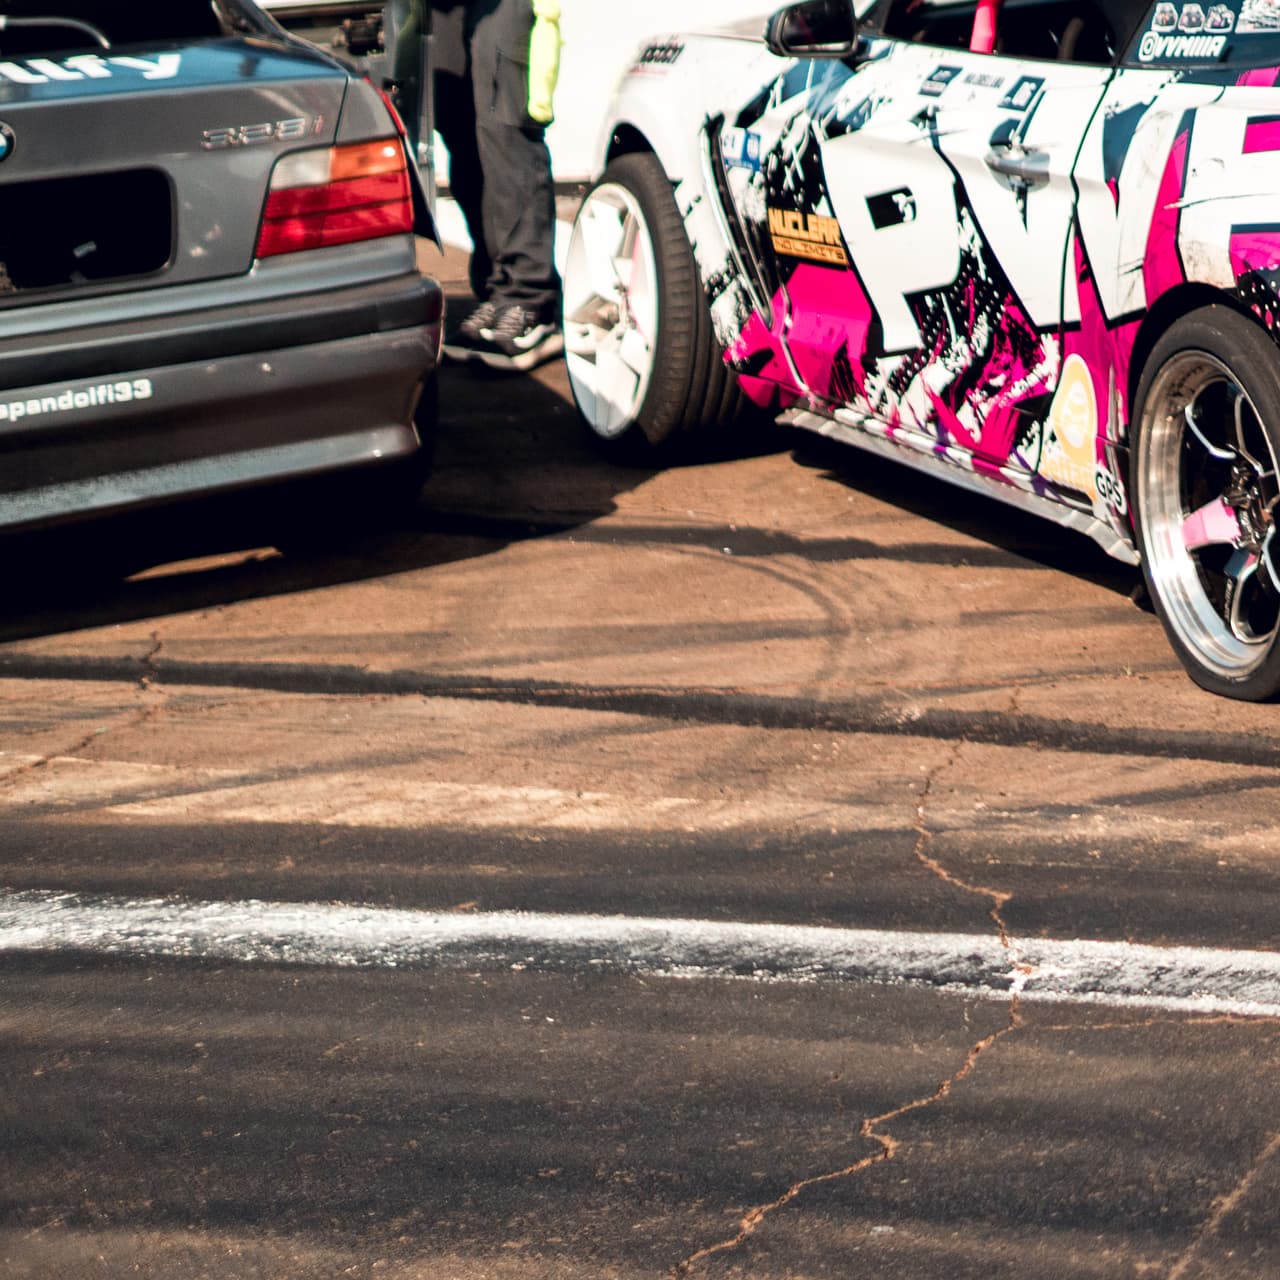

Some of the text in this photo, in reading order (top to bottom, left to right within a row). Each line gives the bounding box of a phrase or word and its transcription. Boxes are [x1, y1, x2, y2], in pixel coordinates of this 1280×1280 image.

[767, 207, 842, 246] NUCLEAR
[794, 240, 845, 261] LIMITS
[1095, 471, 1123, 508] GPS
